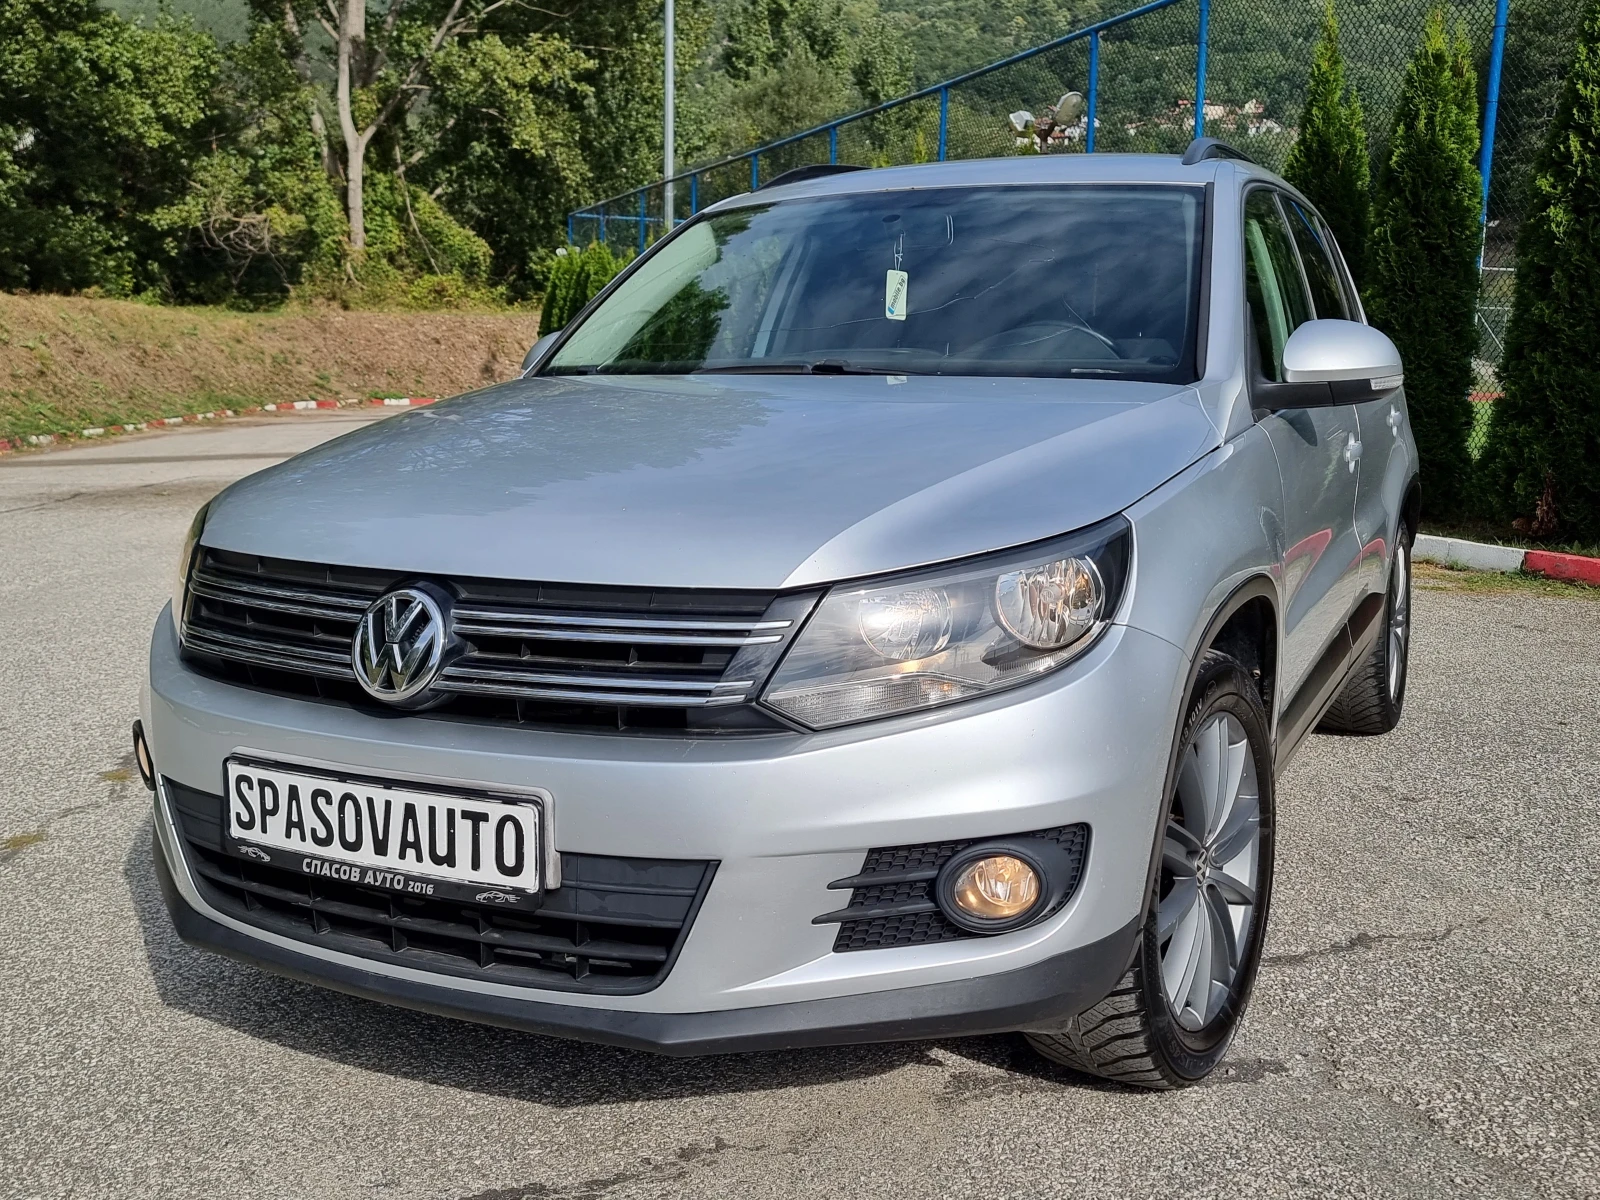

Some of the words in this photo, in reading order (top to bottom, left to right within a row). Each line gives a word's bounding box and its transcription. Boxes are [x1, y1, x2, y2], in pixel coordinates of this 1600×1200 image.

[1188, 698, 1203, 727] 101V
[234, 774, 525, 878] SPASOVAUTO
[302, 858, 361, 882] СПАСОВ
[363, 870, 405, 890] АУТО
[407, 880, 435, 895] 2016
